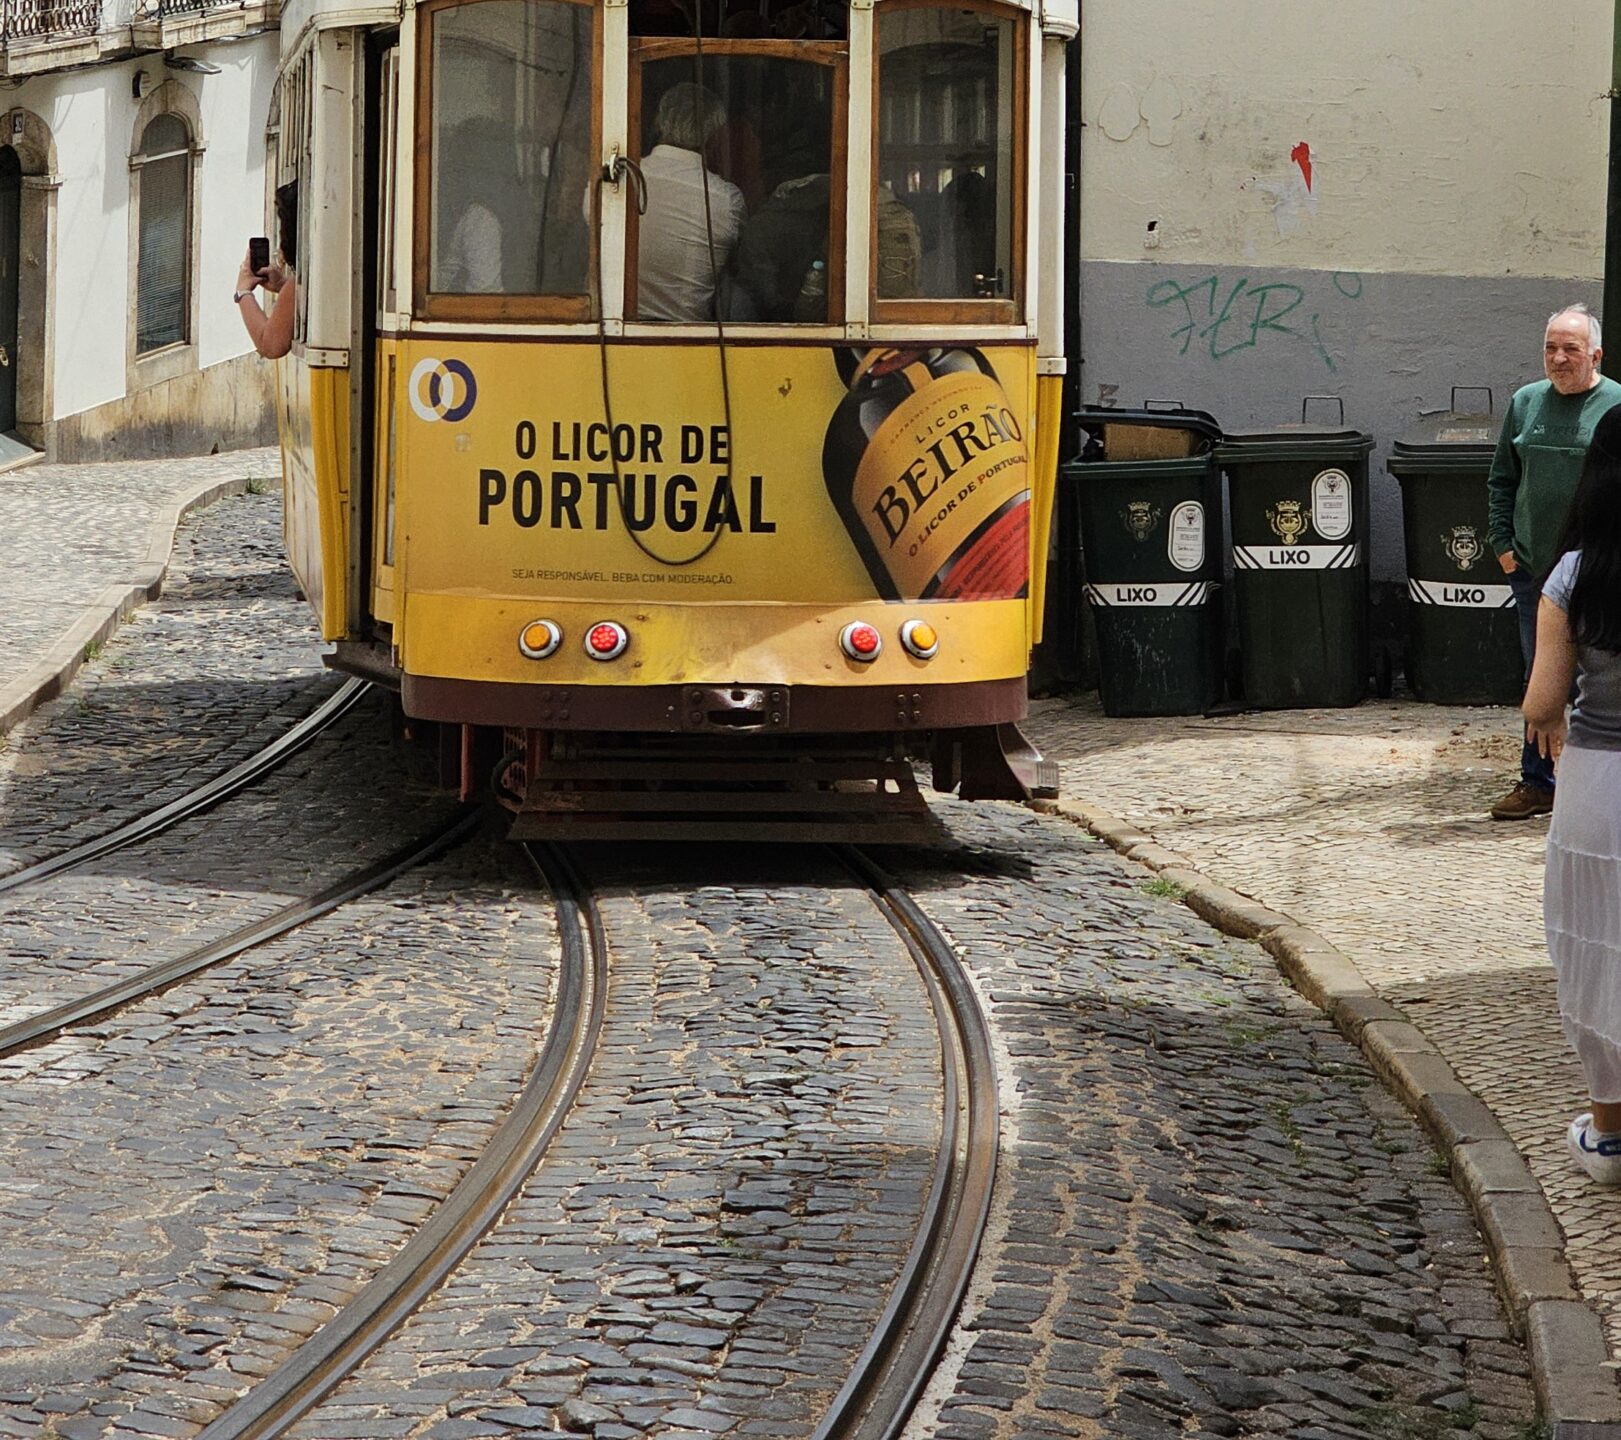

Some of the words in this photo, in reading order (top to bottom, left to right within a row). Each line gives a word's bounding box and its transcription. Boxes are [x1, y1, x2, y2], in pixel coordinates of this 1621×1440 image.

[515, 420, 537, 460] O
[551, 421, 664, 464] LICOR
[680, 424, 732, 465] DE
[916, 403, 970, 444] LICOR
[872, 404, 1022, 549] BEIRÃO
[478, 468, 777, 534] PORTUGAL
[908, 542, 918, 558] O
[918, 500, 959, 546] LICOR
[957, 480, 978, 502] DE
[977, 454, 1028, 486] PORTUGAL
[511, 568, 535, 580] SEJA
[612, 572, 641, 583] BEBA
[641, 573, 665, 584] COM
[1268, 549, 1311, 566] LIXO
[1116, 586, 1158, 604] LIXO
[1442, 587, 1486, 605] LIXO
